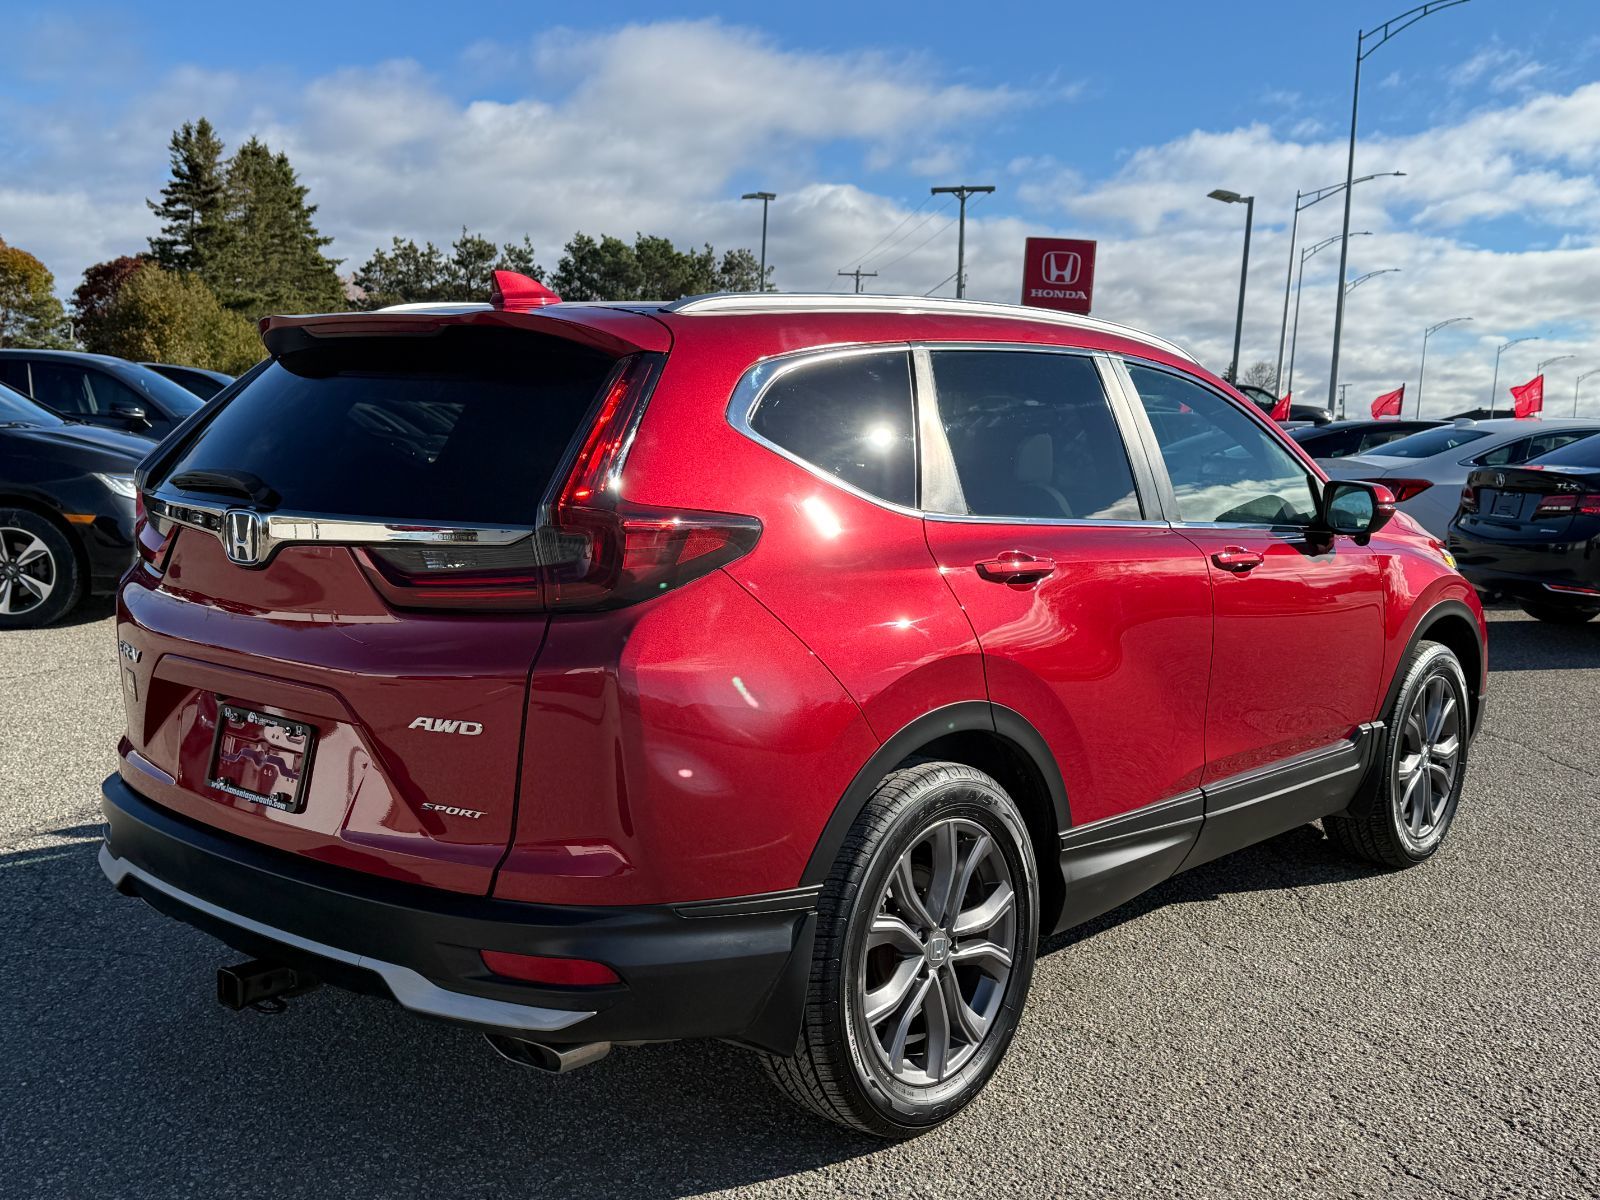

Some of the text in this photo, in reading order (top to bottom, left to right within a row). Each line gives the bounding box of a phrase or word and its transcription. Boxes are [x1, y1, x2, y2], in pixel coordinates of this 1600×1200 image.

[1030, 288, 1088, 300] HONDA
[407, 716, 484, 736] AWD
[421, 802, 488, 819] SPORT
